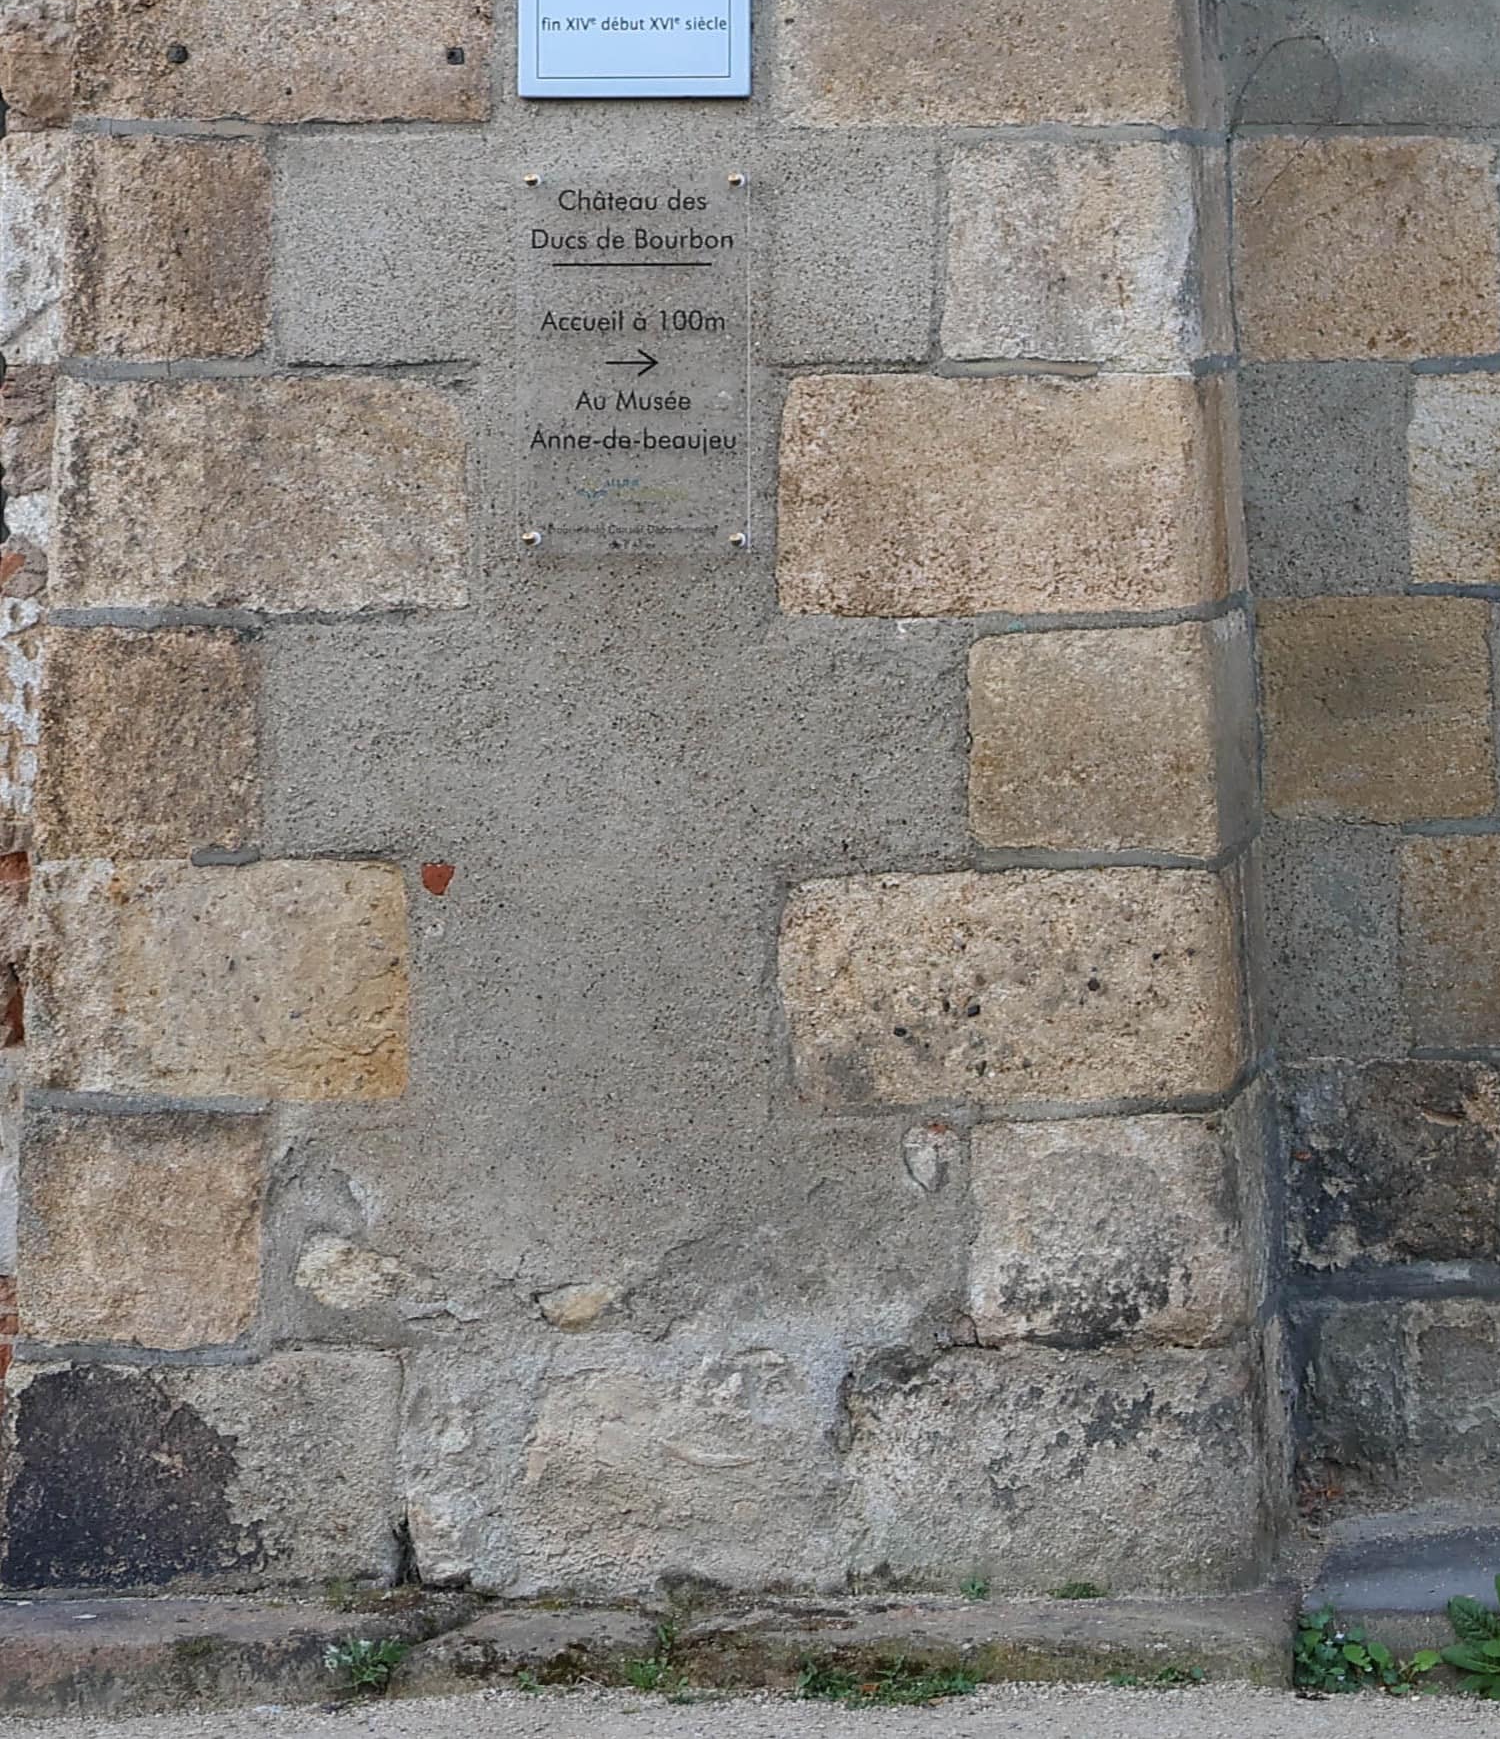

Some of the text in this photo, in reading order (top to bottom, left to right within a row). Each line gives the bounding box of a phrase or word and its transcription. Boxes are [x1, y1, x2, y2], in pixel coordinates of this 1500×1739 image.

[541, 17, 561, 31] fin
[601, 17, 645, 31] début
[685, 16, 727, 31] siècle
[558, 189, 707, 212] Château des
[531, 228, 734, 251] Ducs de Bourbon
[540, 309, 725, 332] Accueil à 100m
[575, 389, 691, 412] Au Musée
[530, 427, 737, 456] Anne-de-beaujeu
